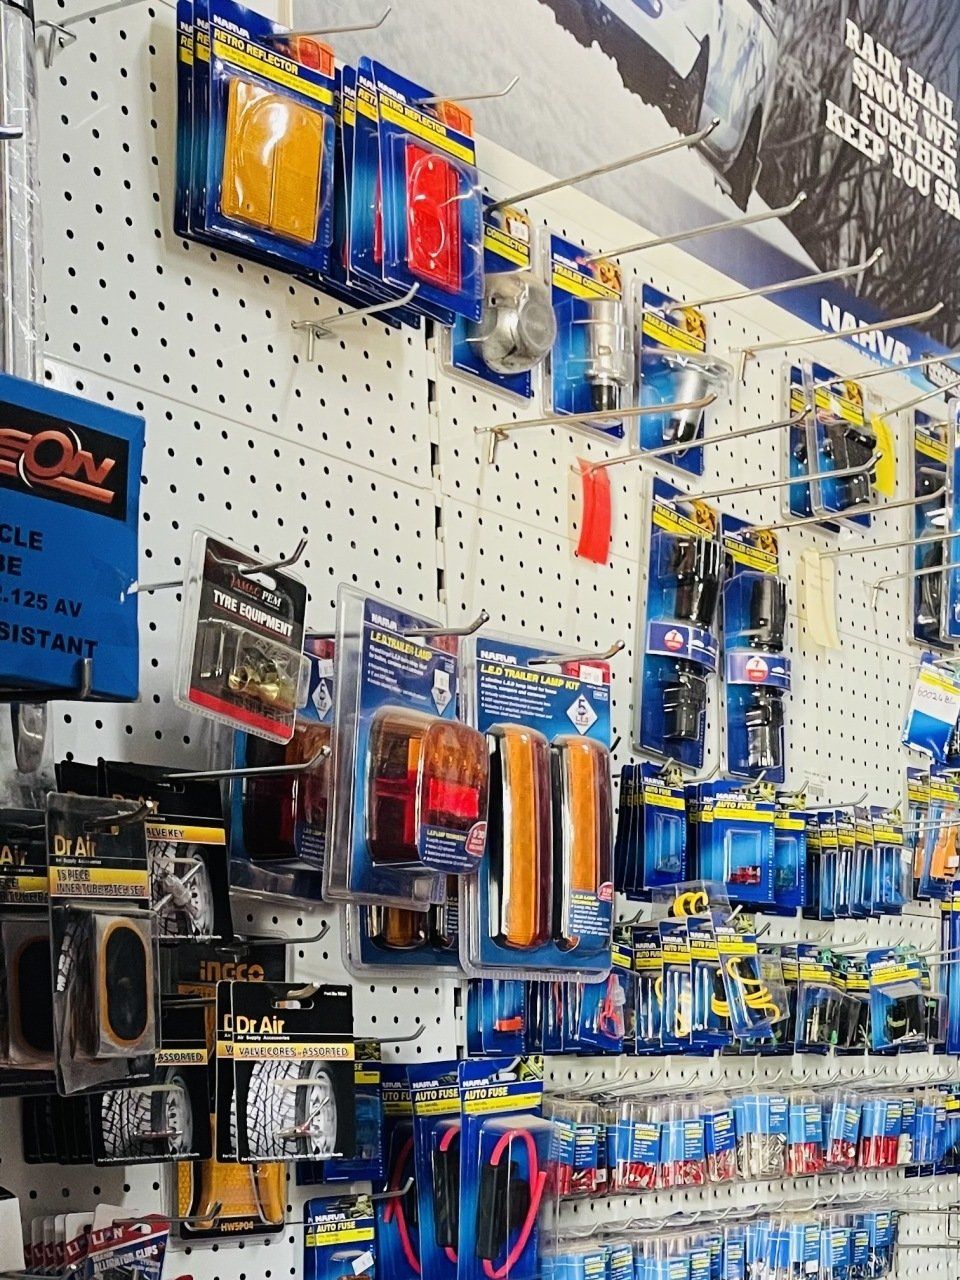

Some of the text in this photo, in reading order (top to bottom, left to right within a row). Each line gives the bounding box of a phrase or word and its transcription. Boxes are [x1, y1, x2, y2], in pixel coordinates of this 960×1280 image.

[214, 15, 249, 39] NARVA
[214, 28, 244, 53] RETRO
[246, 43, 298, 75] REFLECTOR
[846, 18, 903, 93] RAIN,
[907, 67, 957, 130] HAIL
[377, 80, 406, 103] NARVA
[380, 93, 446, 135] RETRO REFLECTOR
[853, 57, 918, 126] SNOW
[923, 110, 957, 158] WE
[826, 99, 885, 164] KEEP
[890, 146, 930, 197] YOU
[860, 93, 957, 189] FURTHER
[486, 228, 530, 255] CONNECTOR
[555, 266, 582, 284] TRAILER
[644, 313, 667, 332] TRAILER
[262, 591, 282, 607] PEM
[54, 598, 83, 618] AV
[213, 589, 293, 637] TYRE EQUIPMENT
[371, 613, 397, 631] NARVA
[414, 644, 432, 661] LAMP
[481, 650, 517, 665] NARVA
[504, 666, 539, 684] TRAILER
[540, 674, 563, 688] LAMP
[566, 678, 580, 692] KIT
[644, 776, 665, 785] NARVA
[645, 787, 671, 796] AUTO FUSE
[716, 793, 747, 801] NARVA
[716, 801, 756, 810] AUTO FUSE
[168, 828, 184, 839] KEY
[55, 835, 96, 857] Dr Air
[68, 869, 90, 881] PIECE
[57, 883, 145, 895] INNER TUBE PATCH SET
[236, 1016, 285, 1034] Dr Air
[239, 1047, 348, 1057] VALVE CORES ASSORTED
[413, 1080, 439, 1088] NARVA
[462, 1078, 489, 1088] NARVA
[415, 1088, 459, 1101] AUTO FUSE
[464, 1087, 508, 1101] AUTO FUSE
[315, 1213, 345, 1223] NARVA
[317, 1221, 356, 1233] AUTO FUSE
[135, 1245, 159, 1259] CLIPS
